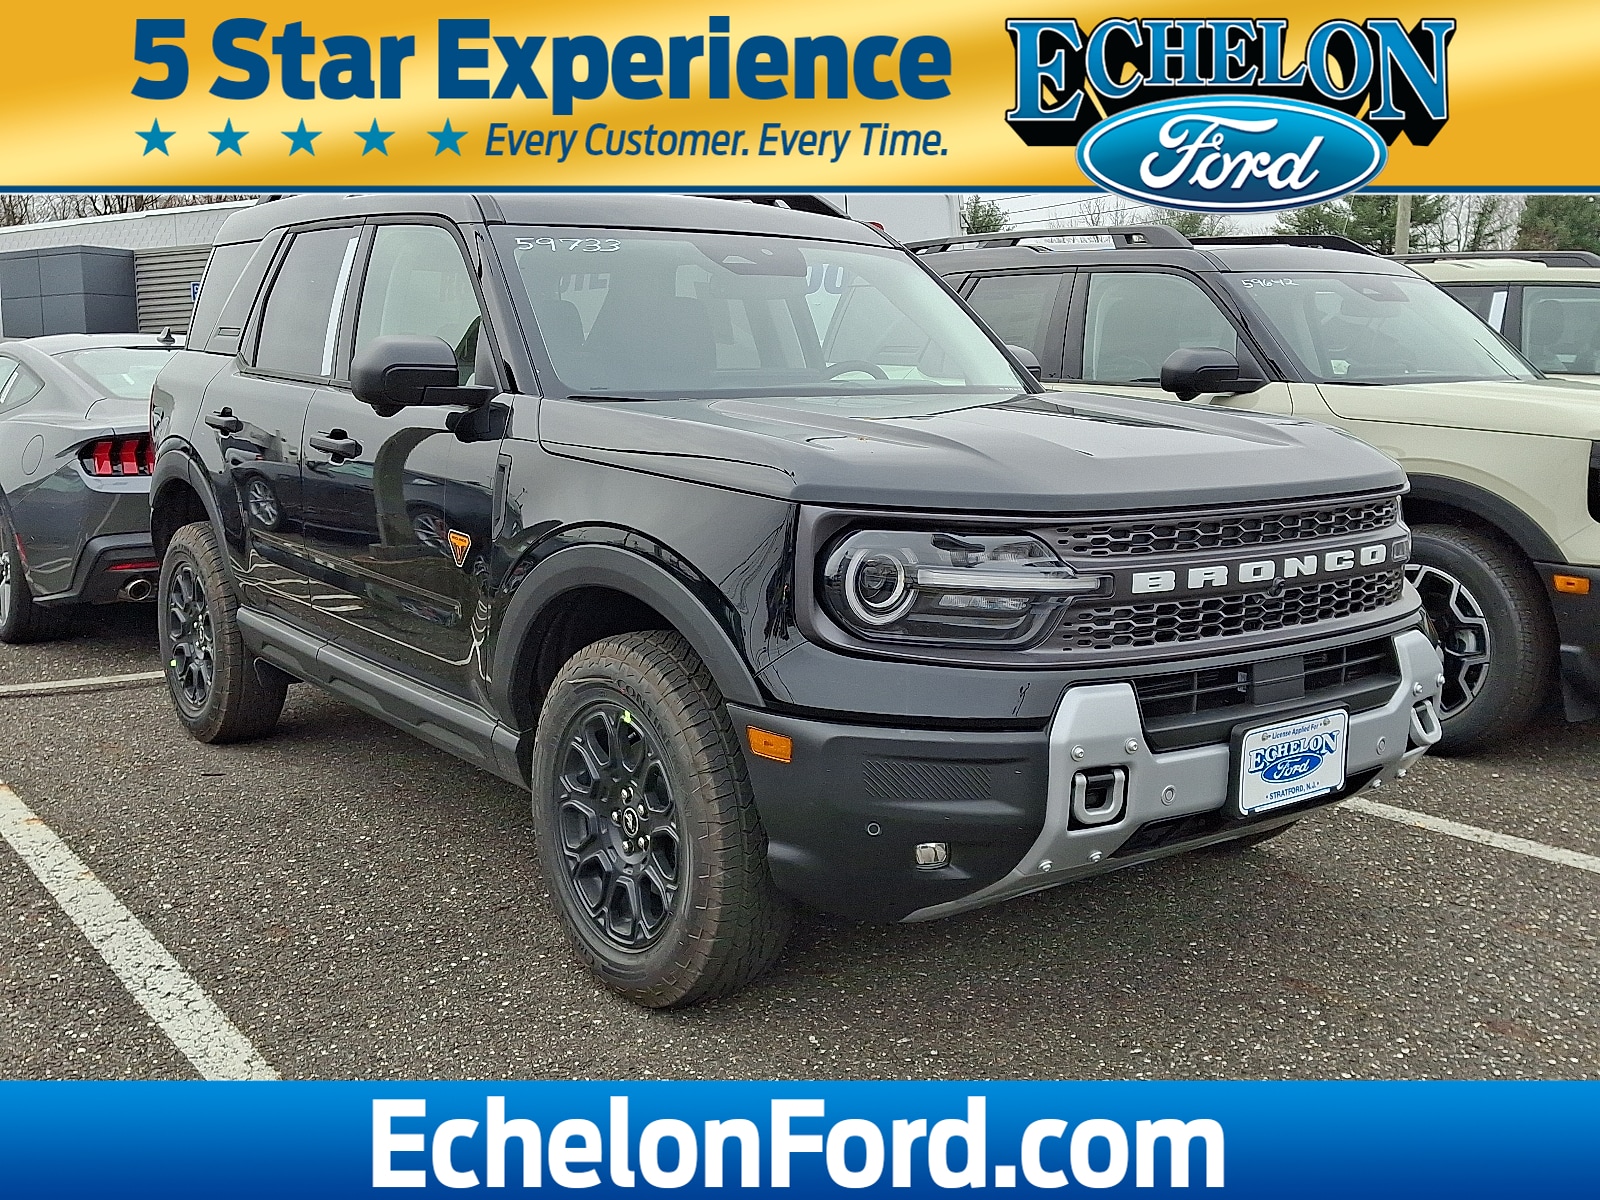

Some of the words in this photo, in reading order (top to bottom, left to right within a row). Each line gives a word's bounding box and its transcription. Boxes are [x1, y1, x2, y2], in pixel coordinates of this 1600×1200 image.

[514, 237, 621, 252] 59733
[1241, 278, 1299, 289] 59642
[1131, 543, 1387, 595] BRONCO
[1271, 730, 1292, 740] License
[1292, 724, 1310, 736] Applied
[1310, 723, 1319, 731] For
[1247, 730, 1340, 775] ECHELON
[1273, 756, 1310, 780] Ford
[1269, 784, 1306, 800] STRATFORD,
